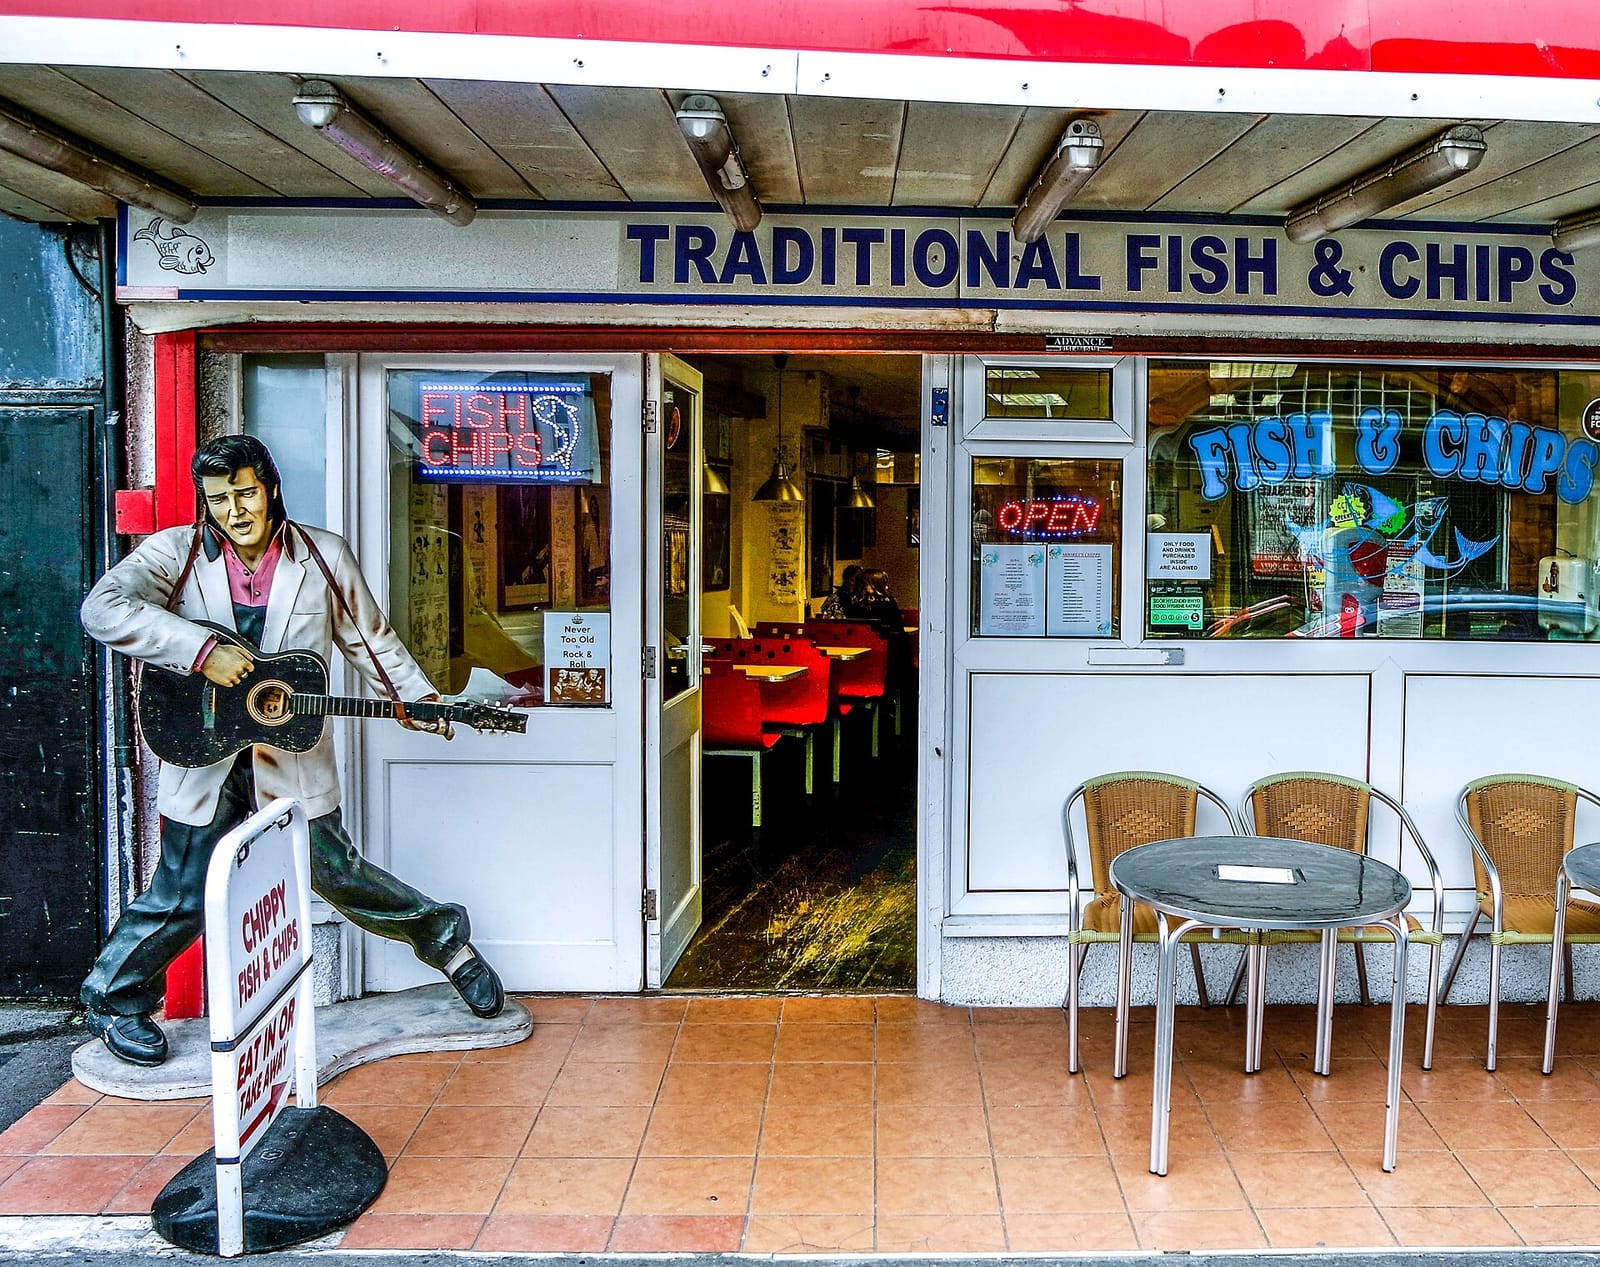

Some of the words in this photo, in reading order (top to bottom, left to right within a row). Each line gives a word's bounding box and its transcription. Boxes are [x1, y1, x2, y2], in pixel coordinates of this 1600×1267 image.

[626, 223, 1102, 291] TRADITIONAL
[1126, 233, 1278, 296] FISH
[1308, 238, 1355, 298] &
[1378, 240, 1578, 306] CHIPS
[1054, 337, 1106, 346] ADVANCE
[421, 393, 527, 429] FISH
[421, 431, 543, 466] CHIPS
[1188, 410, 1336, 501] FISH
[1354, 405, 1403, 476] &
[1422, 408, 1600, 505] CHIPS
[999, 502, 1101, 531] OPEN
[560, 635, 577, 643] Too
[579, 635, 595, 643] Old
[563, 650, 584, 658] Rock
[569, 660, 586, 668] Roll
[242, 878, 286, 953] CHIPPY
[238, 955, 260, 1008] FISH
[263, 947, 270, 981] &
[272, 918, 298, 970] CHIPS
[237, 1034, 261, 1091] EAT
[263, 1017, 277, 1061] IN
[279, 997, 295, 1040] OR
[239, 1071, 262, 1121] TAKE
[263, 1040, 289, 1093] AWAY
